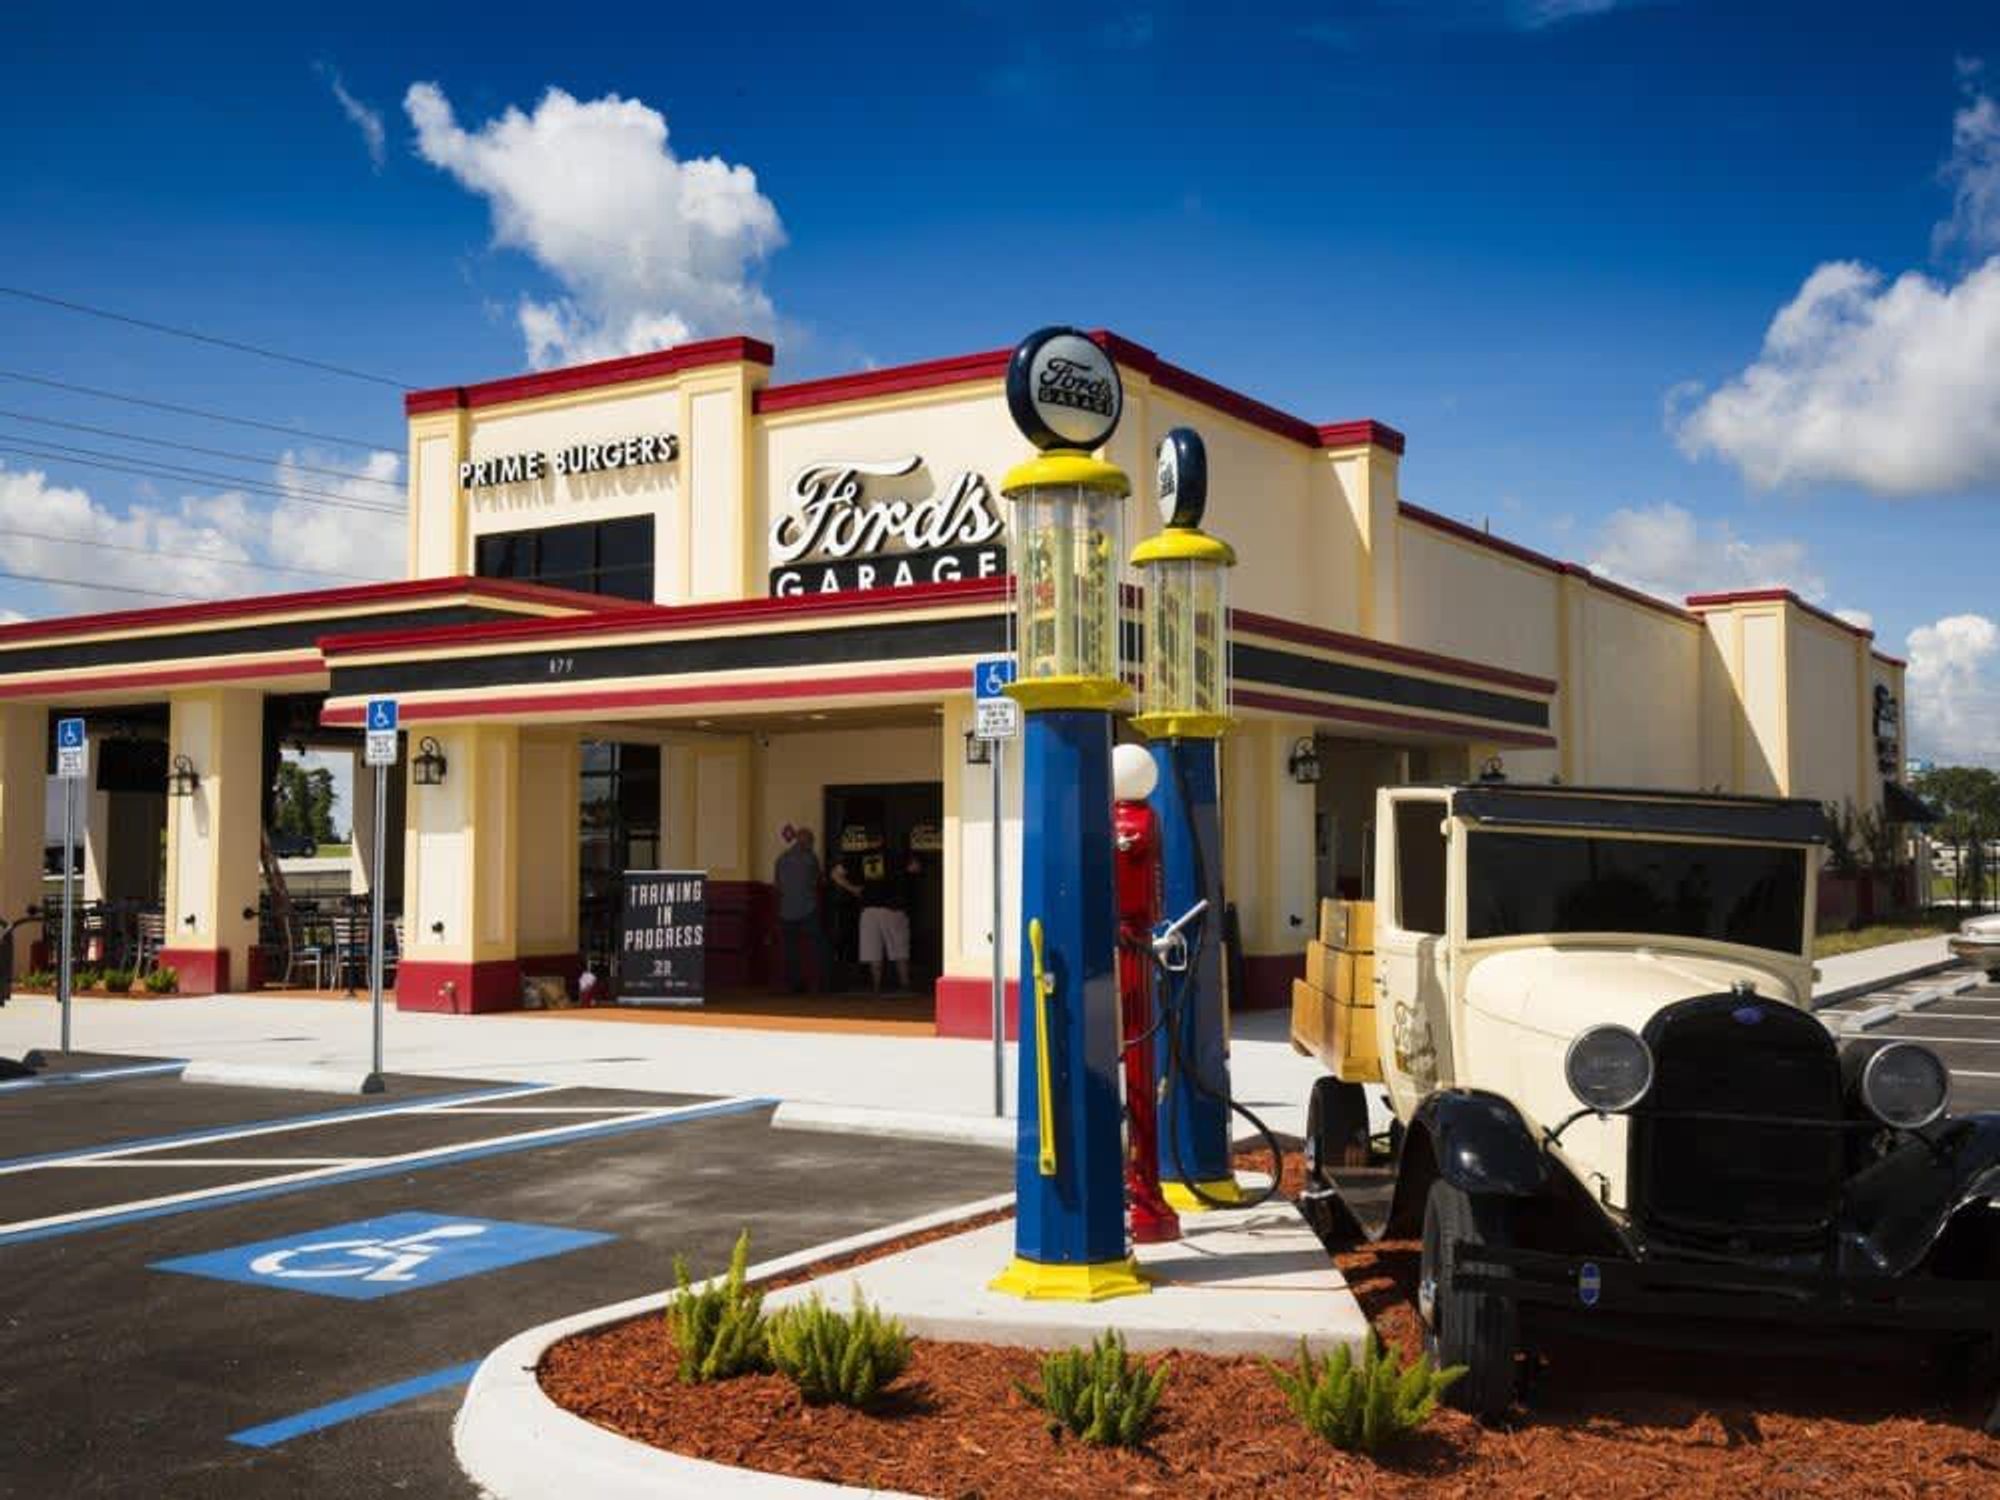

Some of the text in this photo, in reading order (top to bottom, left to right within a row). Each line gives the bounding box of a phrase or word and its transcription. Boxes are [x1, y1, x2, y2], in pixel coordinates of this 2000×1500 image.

[459, 433, 681, 489] PRIME BURGERS
[769, 455, 1004, 562] Ford's
[631, 881, 702, 907] TRAINING
[657, 905, 672, 926] IN
[624, 926, 704, 951] PROGRESS
